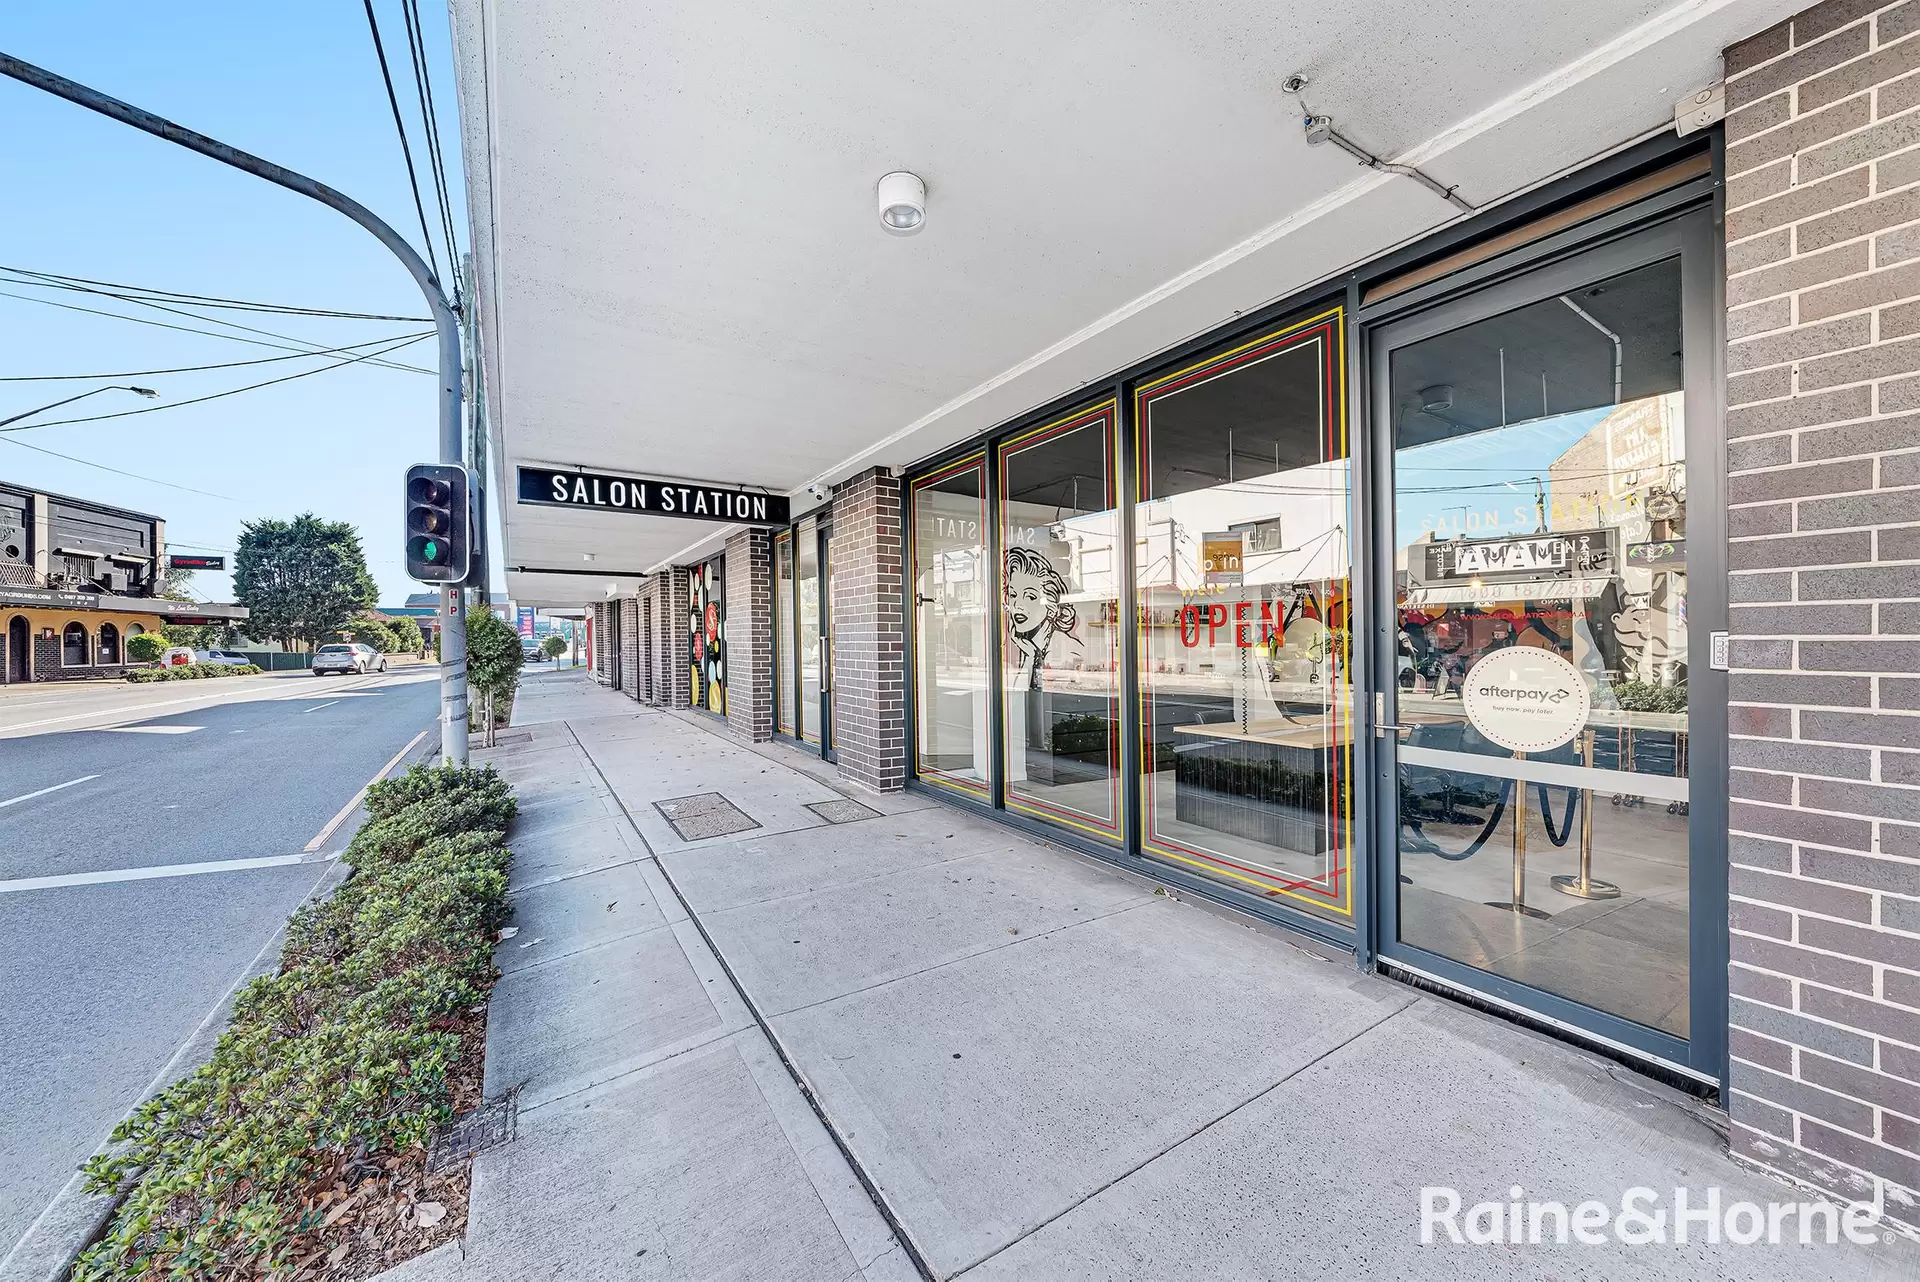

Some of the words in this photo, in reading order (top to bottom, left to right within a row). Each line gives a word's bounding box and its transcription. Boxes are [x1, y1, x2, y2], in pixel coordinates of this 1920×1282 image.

[552, 475, 646, 509] SALON
[661, 486, 766, 520] STATION
[1421, 510, 1499, 534] SALON
[1514, 493, 1641, 525] STATI
[1181, 600, 1284, 648] OPEN
[1479, 685, 1549, 703] afterpay
